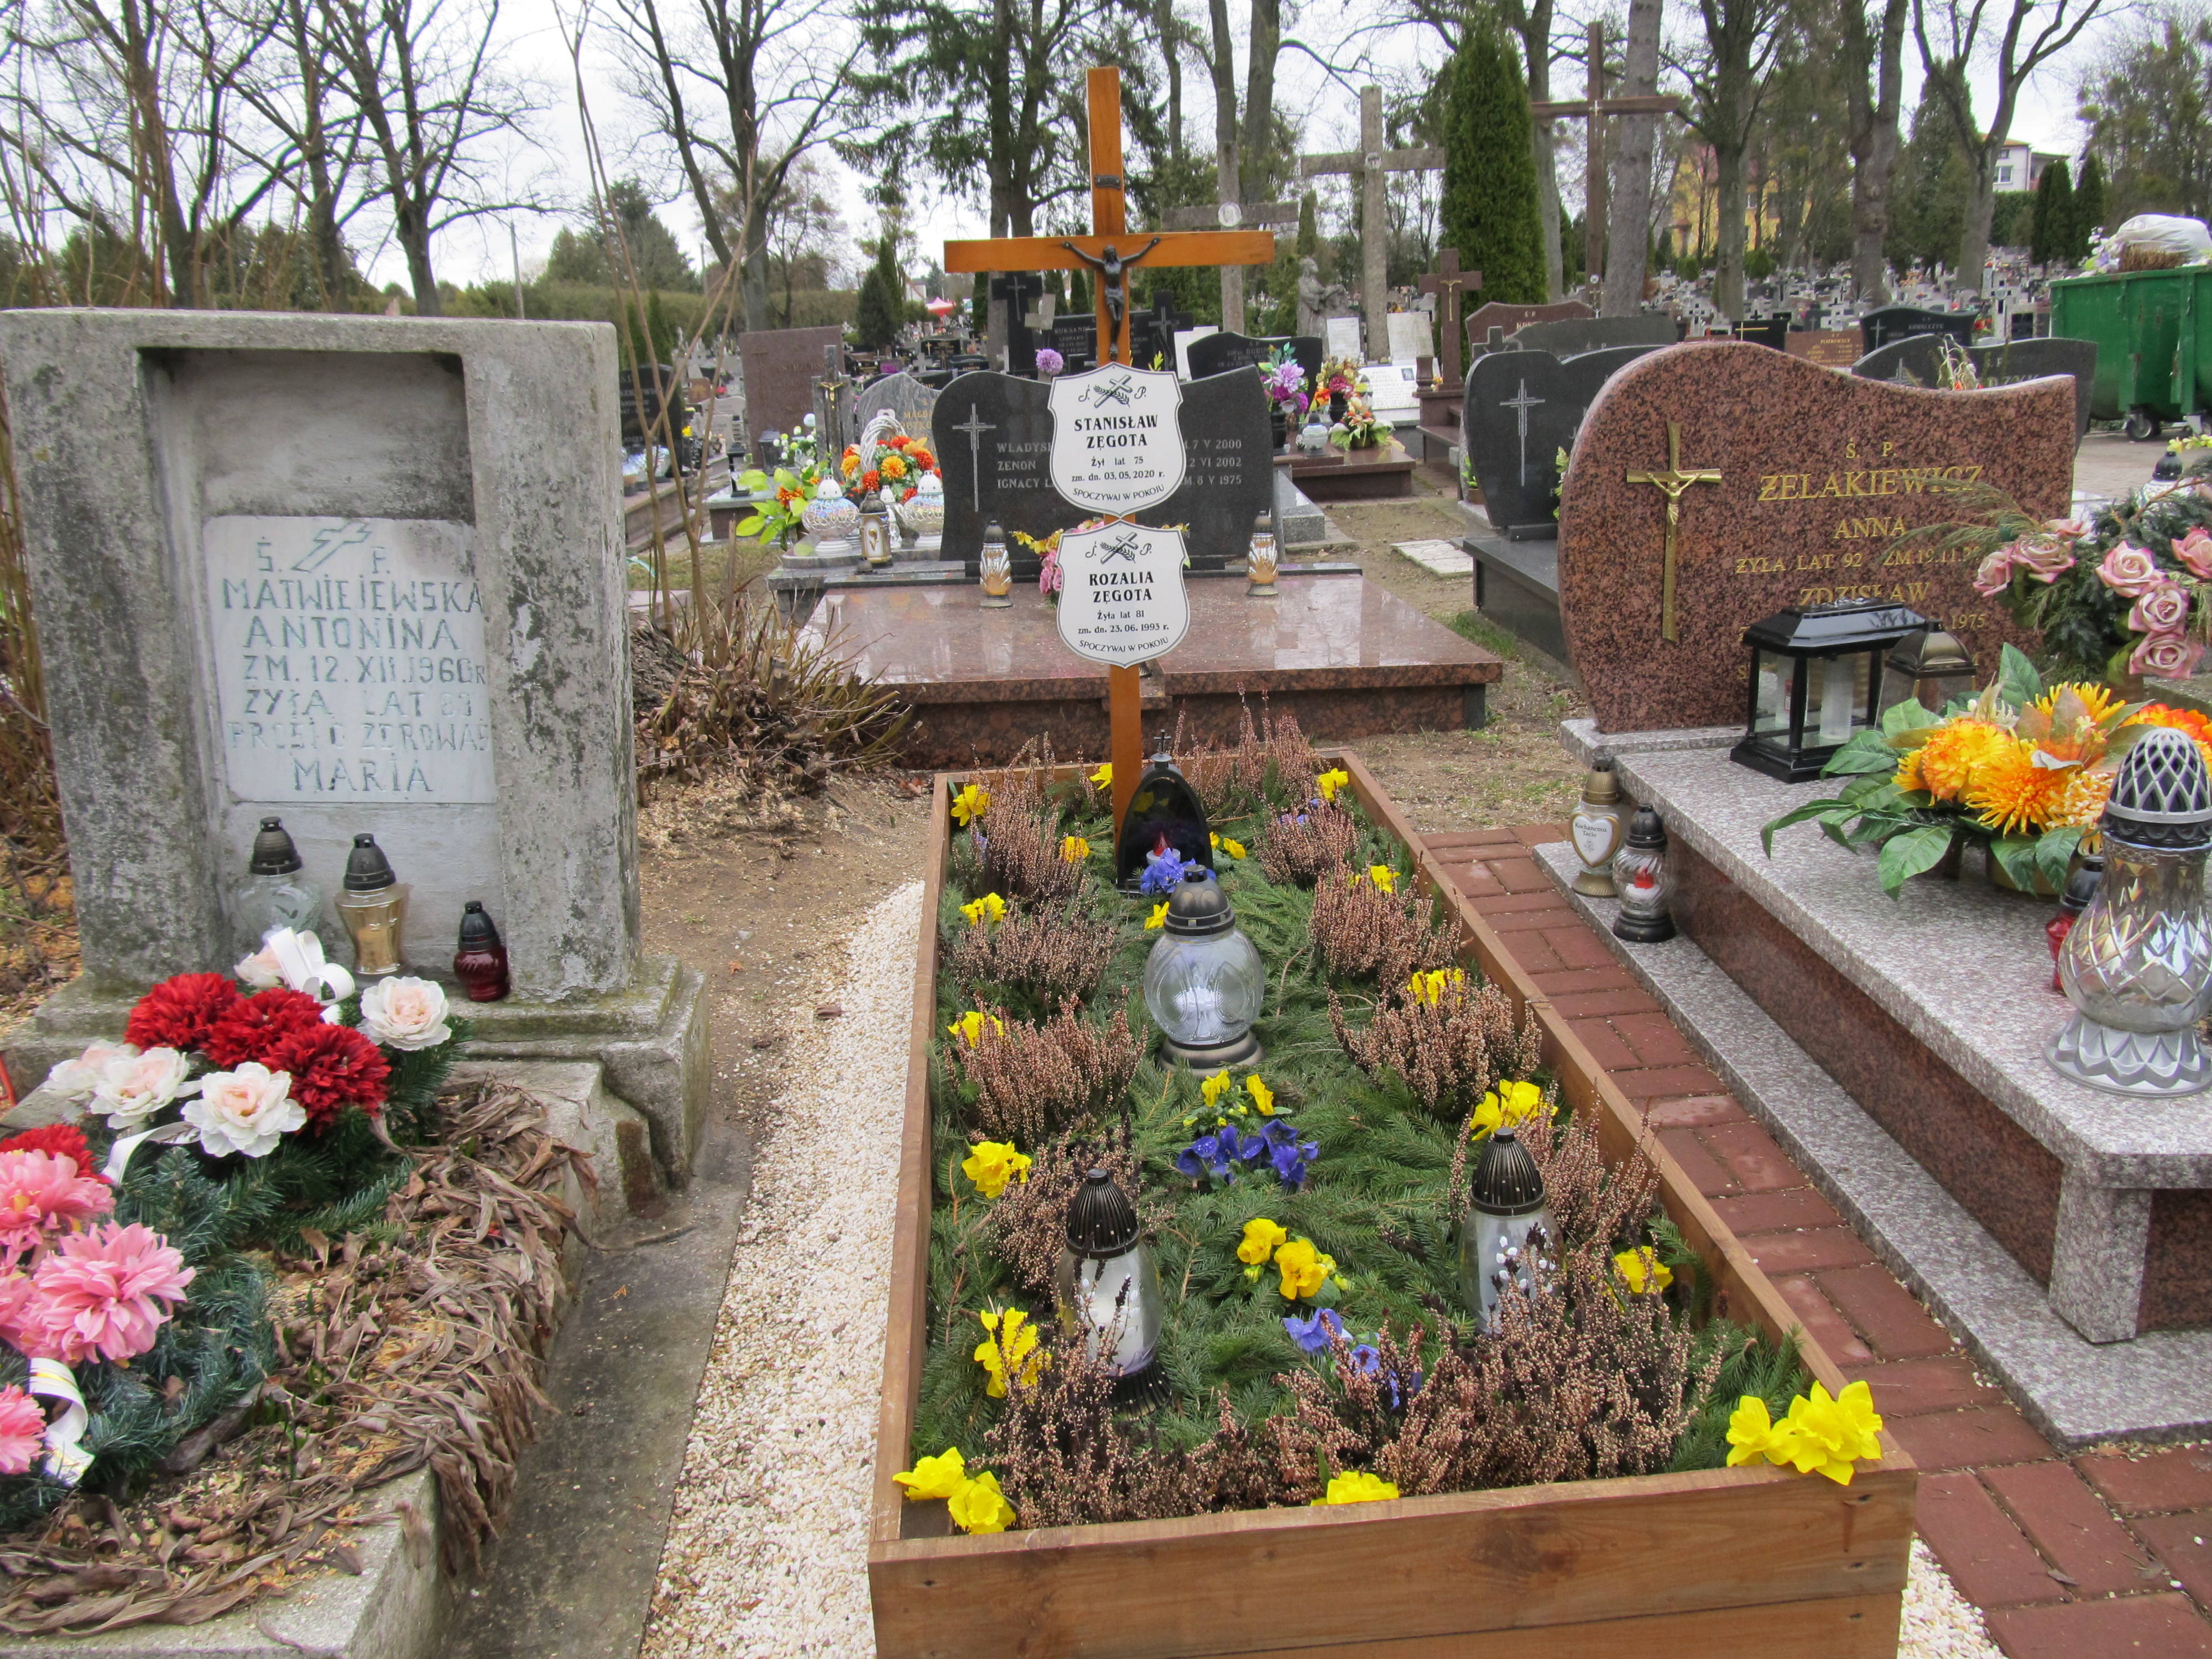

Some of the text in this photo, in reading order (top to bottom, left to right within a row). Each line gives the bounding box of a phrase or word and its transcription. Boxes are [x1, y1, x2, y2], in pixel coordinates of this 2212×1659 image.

[1074, 415, 1158, 431] STANISŁAW
[1087, 434, 1147, 451] ZĘGOTA
[1193, 440, 1199, 449] 7
[1203, 440, 1211, 448] V
[1215, 439, 1241, 449] 2000
[1882, 442, 1896, 457] P.
[998, 461, 1036, 471] ZENON
[1199, 457, 1211, 467] VI
[1216, 457, 1241, 467] 2002
[1091, 456, 1144, 468] Żył lat 75
[998, 478, 1039, 488] IGNACY
[1197, 476, 1203, 484] 8
[1208, 476, 1215, 485] V
[1220, 475, 1241, 484] 1975
[1088, 473, 1100, 481] dn.
[1073, 488, 1120, 501] SPOCZYWAJ
[1133, 484, 1165, 499] POKOJU
[1833, 516, 1909, 539] ANNA
[1796, 554, 1834, 571] LAT
[1844, 554, 1863, 567] 92
[1089, 571, 1154, 586] ROZALIA
[222, 574, 483, 613] MATWIEJEWSKA
[1093, 588, 1152, 604] ZĘGOTA
[1097, 610, 1115, 621] Żyła
[243, 613, 461, 650] ANTONINA
[1079, 640, 1126, 653] SPOCZYWAJ
[1138, 637, 1168, 651] POKOJU
[364, 690, 425, 717] LAT
[292, 753, 433, 792] MARIA
